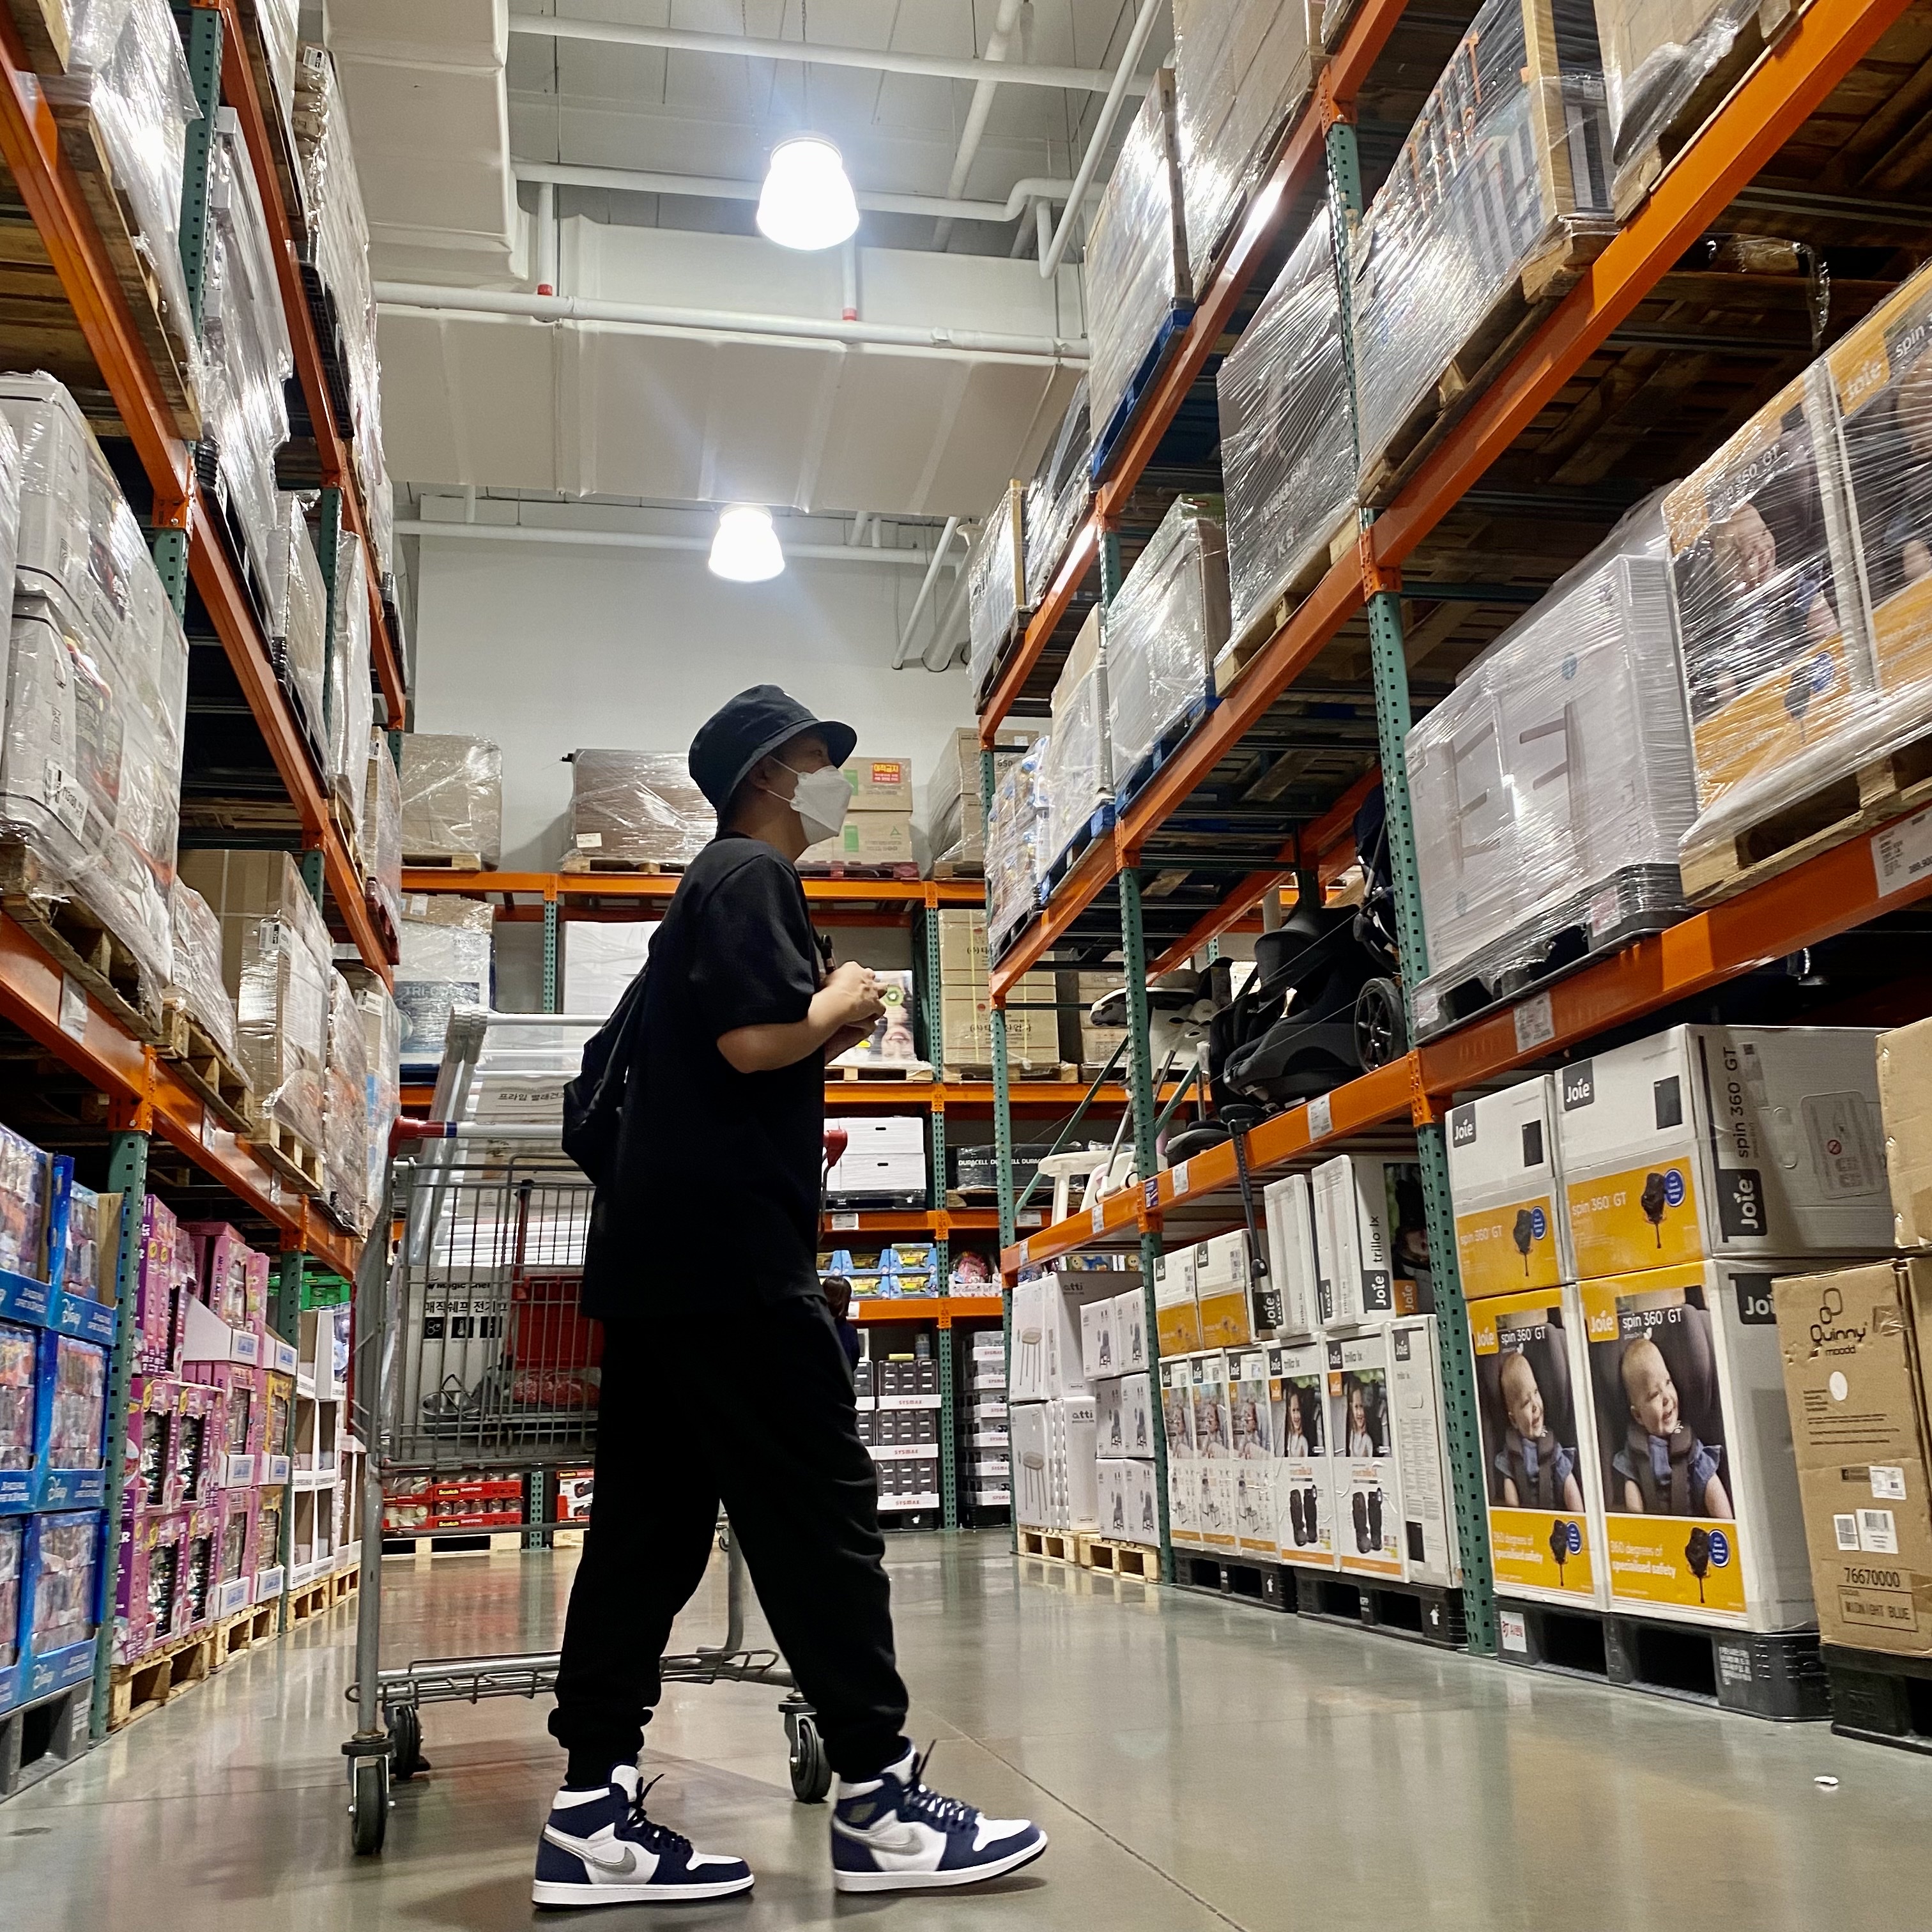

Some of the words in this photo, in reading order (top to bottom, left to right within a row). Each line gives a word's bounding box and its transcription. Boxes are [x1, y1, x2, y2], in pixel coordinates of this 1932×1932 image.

[1895, 325, 1925, 359] spin
[1723, 1046, 1738, 1071] GT
[1567, 1078, 1590, 1103] Joie
[1727, 1082, 1744, 1116] 360
[1455, 1119, 1473, 1140] Joie
[1732, 1123, 1749, 1158] spin
[1572, 1201, 1590, 1216] spin
[1591, 1195, 1609, 1211] 360
[1613, 1192, 1627, 1206] GT
[1733, 1178, 1759, 1229] Joie
[1492, 1225, 1503, 1238] GT
[1371, 1232, 1383, 1263] trillo
[1063, 1283, 1084, 1291] atti
[1372, 1275, 1387, 1306] Joie
[1404, 1285, 1415, 1310] Joie
[1263, 1297, 1276, 1326] Joie
[1745, 1295, 1775, 1315] Joi
[1590, 1310, 1613, 1333] Joie
[1622, 1315, 1642, 1329] spin
[1644, 1312, 1663, 1327] 360
[1668, 1308, 1682, 1323] GT
[1477, 1327, 1494, 1346] Joie
[1501, 1331, 1515, 1344] spin
[1517, 1329, 1532, 1342] 360
[1535, 1326, 1546, 1340] GT
[1810, 1324, 1866, 1346] Quinny
[1073, 1409, 1093, 1419] atti
[1844, 1567, 1901, 1588] 76670000
[1888, 1605, 1911, 1620] BLUE
